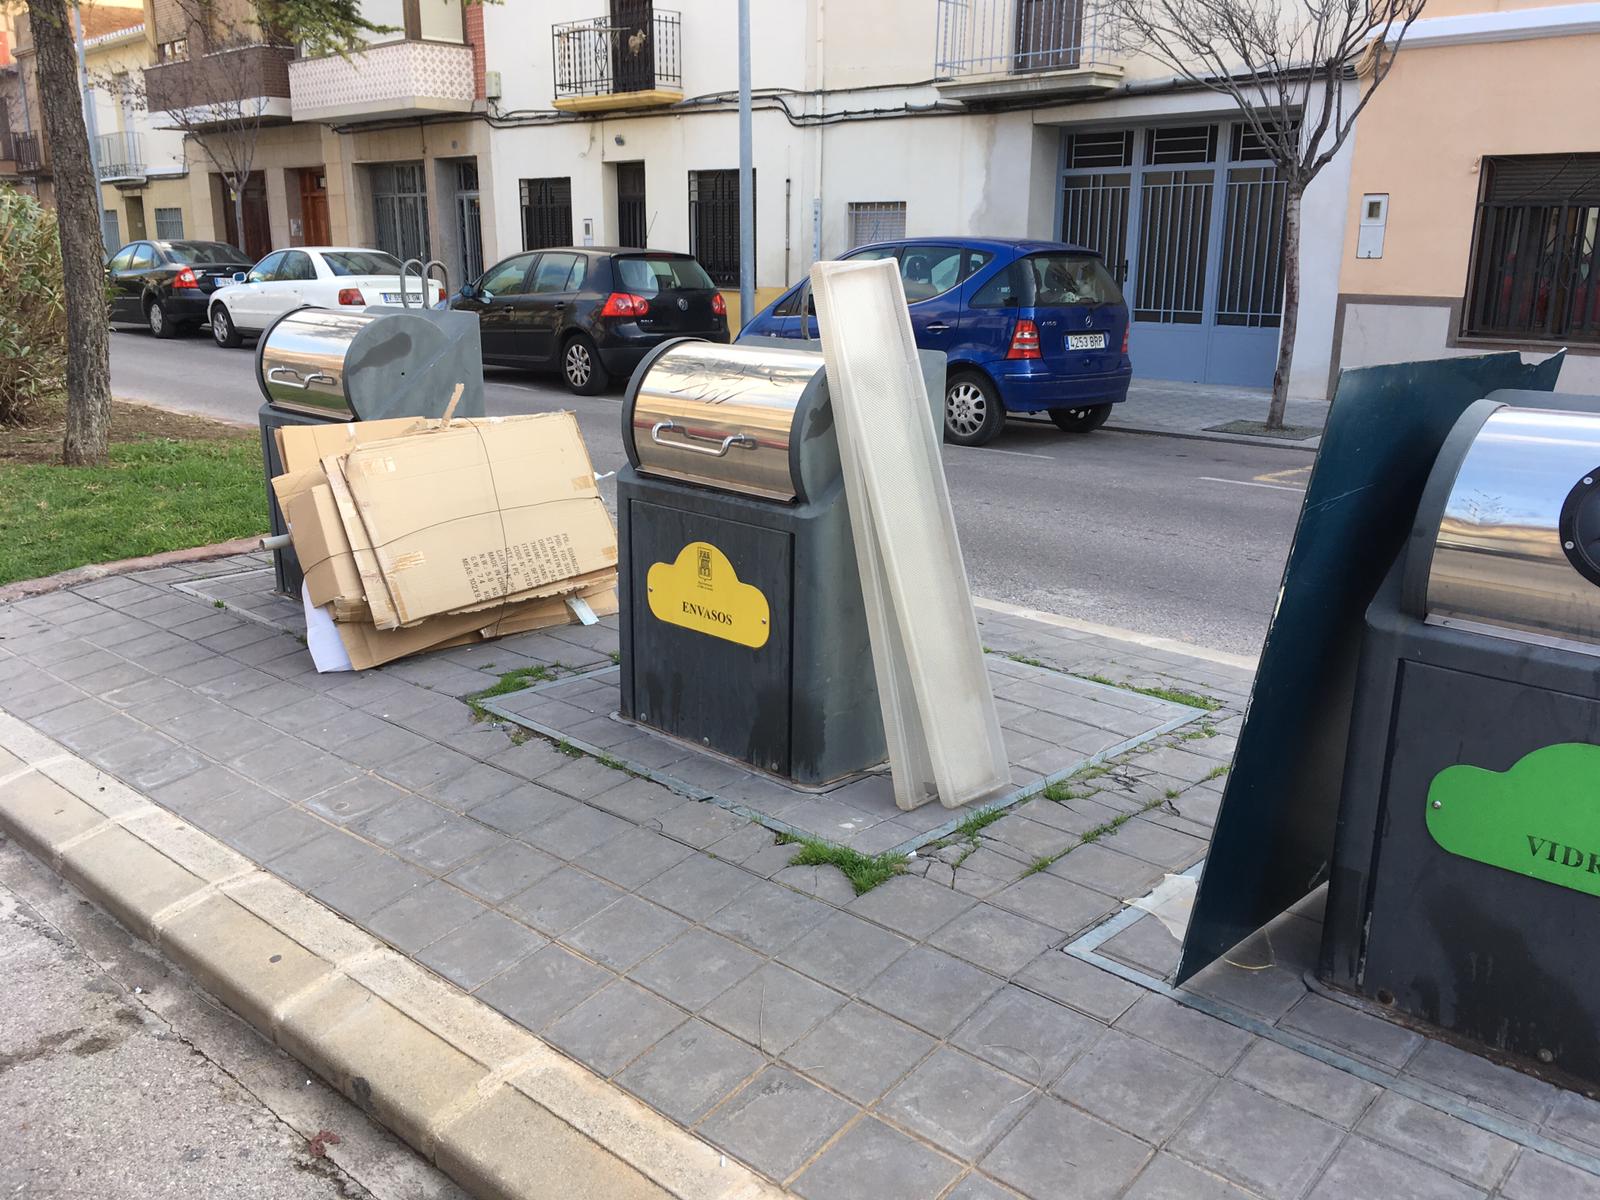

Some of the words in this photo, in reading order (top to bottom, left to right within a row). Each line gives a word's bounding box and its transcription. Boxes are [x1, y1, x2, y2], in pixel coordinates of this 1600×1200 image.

[1069, 335, 1089, 349] 4253
[1089, 335, 1104, 348] BRP
[488, 551, 498, 568] MADE
[682, 600, 733, 626] ENVASOS
